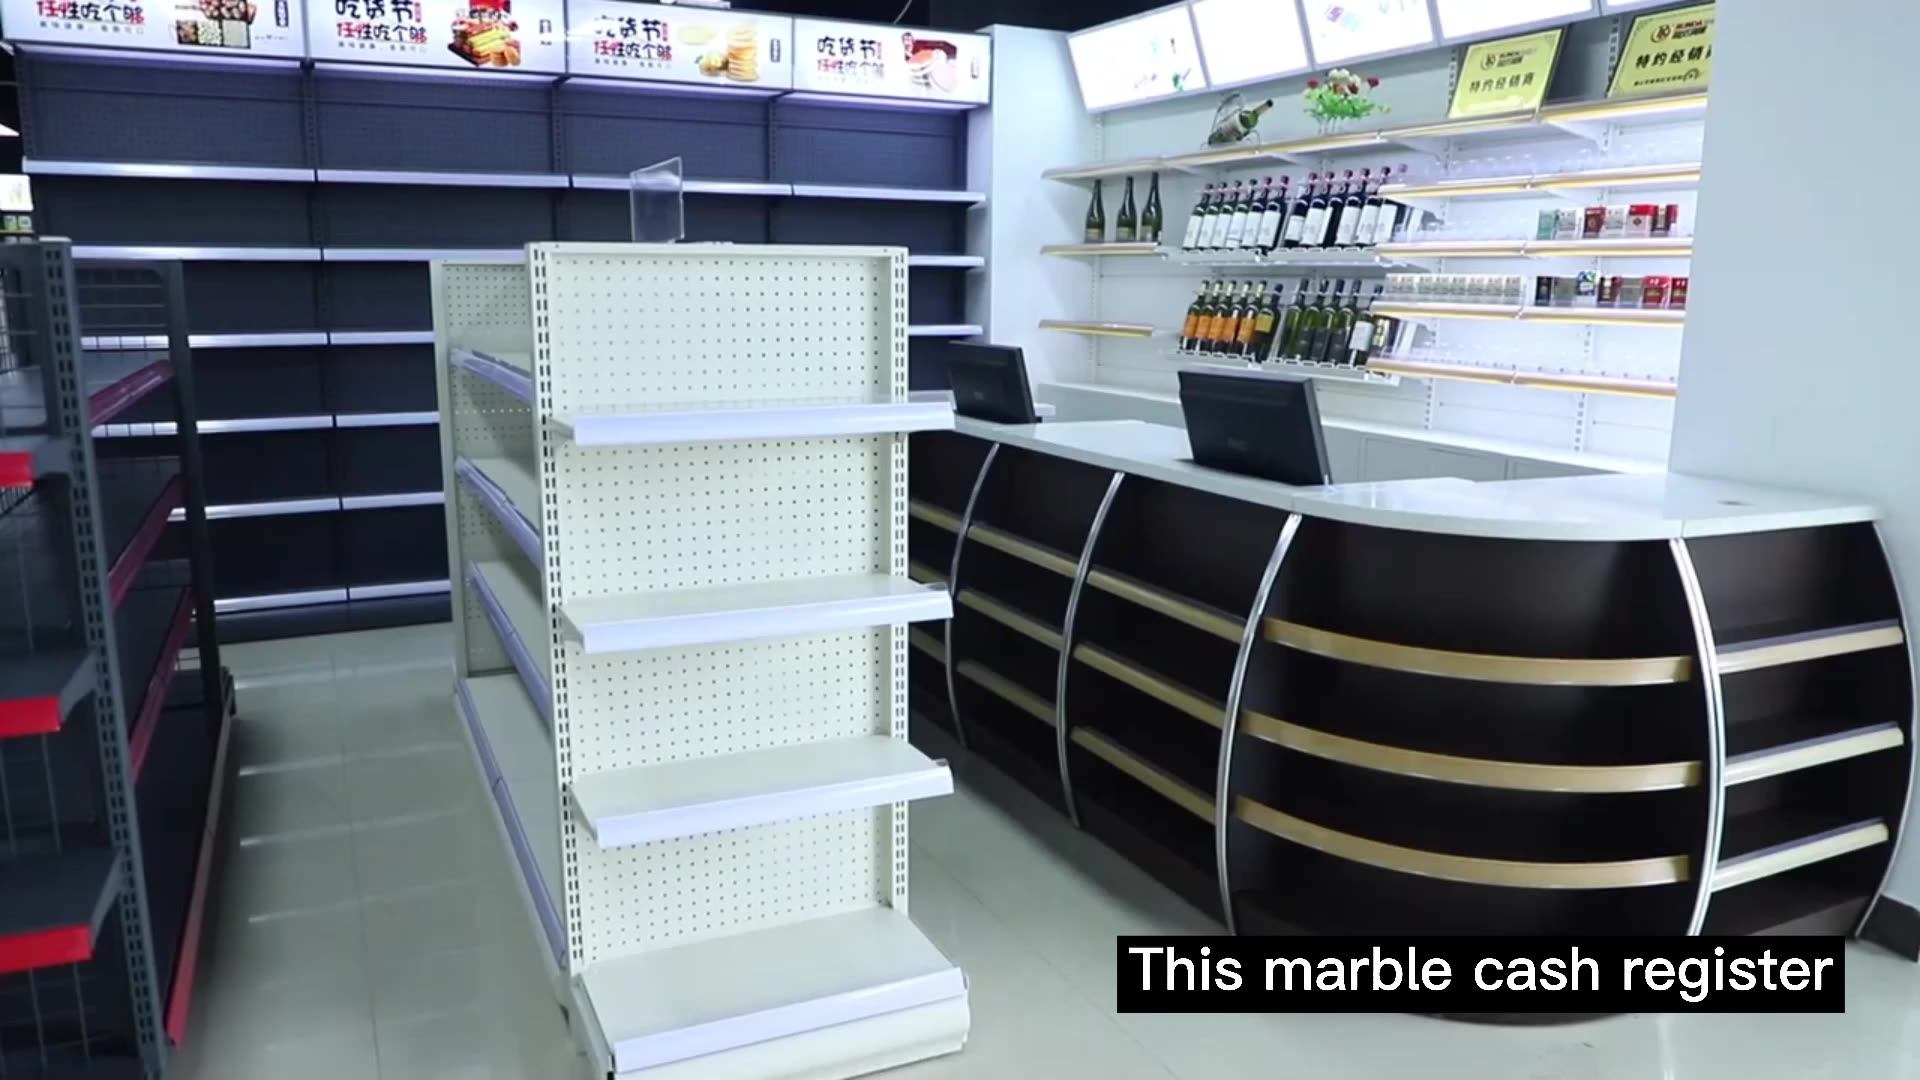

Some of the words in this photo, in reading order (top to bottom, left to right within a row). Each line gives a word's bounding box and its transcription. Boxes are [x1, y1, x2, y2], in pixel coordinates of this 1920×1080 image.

[37, 0, 144, 24] 任性吃个够
[337, 22, 427, 43] 任性吃个够
[594, 41, 672, 60] 任性吃个够
[817, 37, 876, 59] 吃货节
